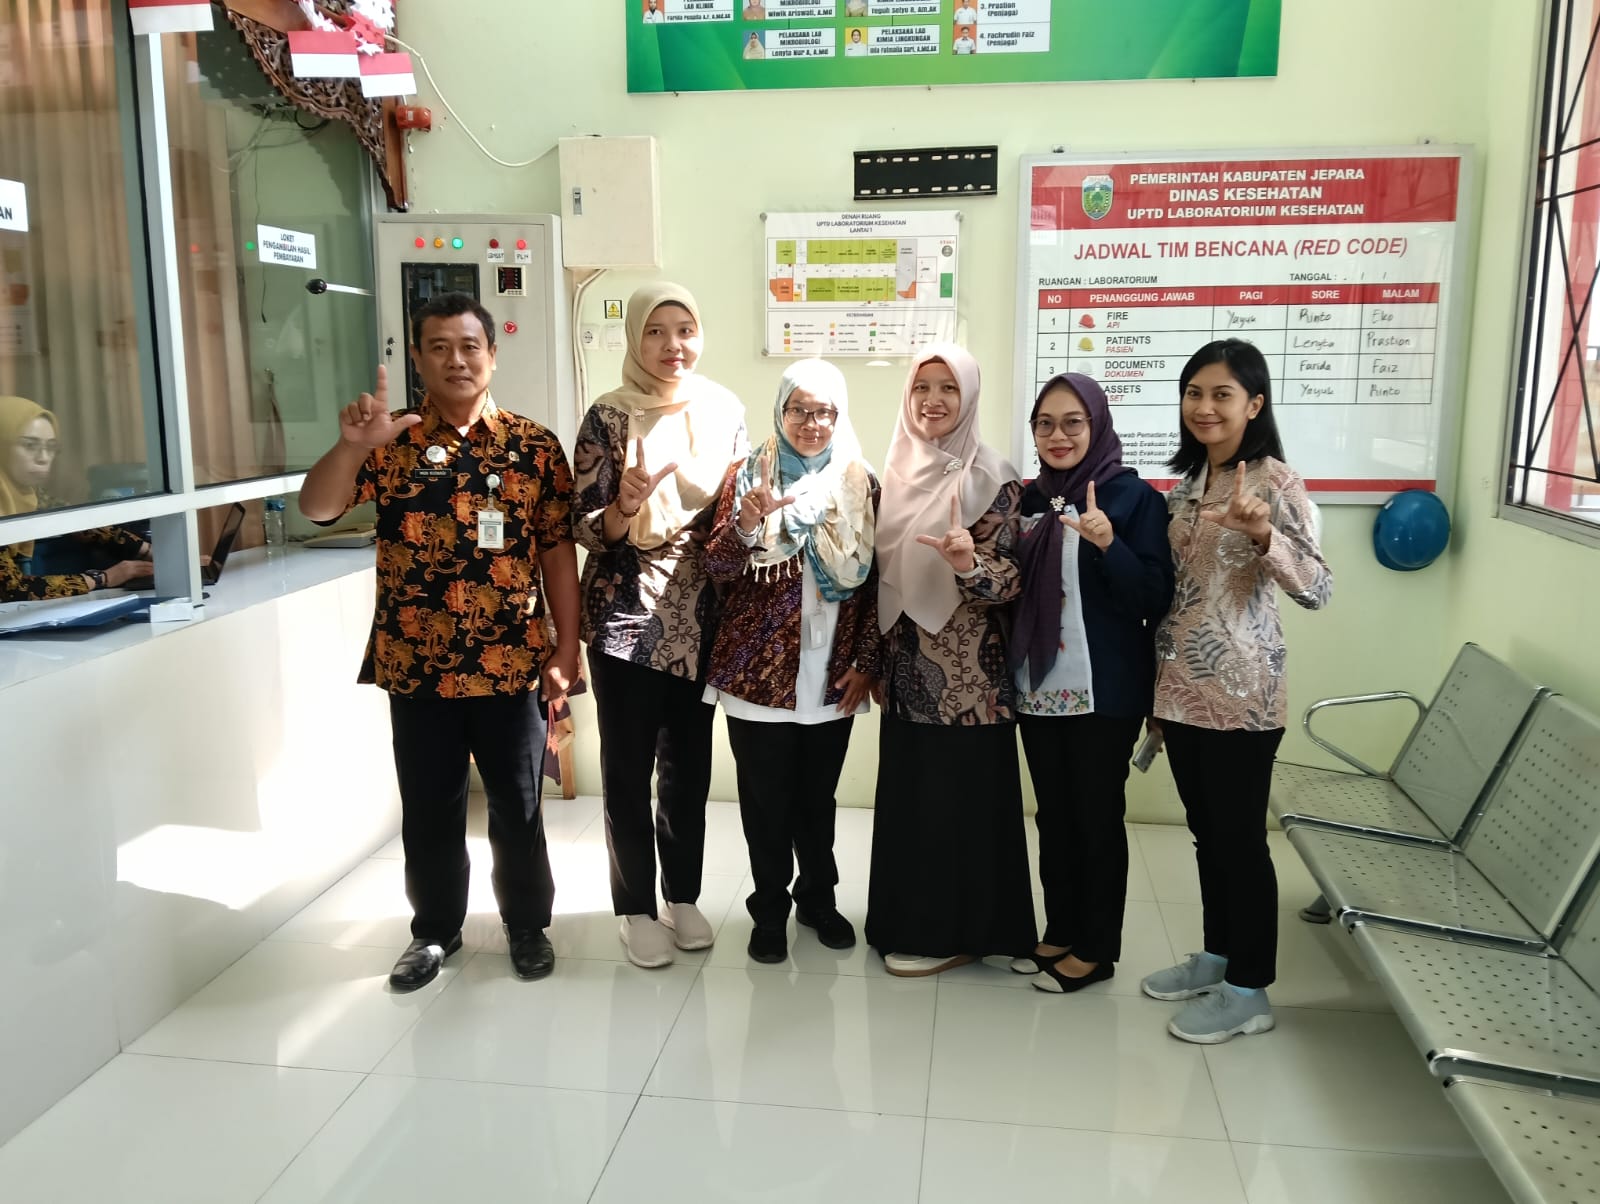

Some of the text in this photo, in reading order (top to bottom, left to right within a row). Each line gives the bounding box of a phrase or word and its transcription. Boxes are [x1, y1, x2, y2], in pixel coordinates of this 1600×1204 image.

[1130, 168, 1365, 184] PEMERINTAH KABUPATEN JEPARA
[1169, 186, 1322, 202] DINAS KESEHATAN
[1127, 204, 1364, 220] UPTD LABORATORIUM KESEHATAN
[280, 233, 295, 242] LOKET
[1073, 237, 1408, 260] JADWAL TIM BENCANA (RED CODE)
[1038, 277, 1081, 286] RUANGAN
[1088, 276, 1158, 286] LABORATORIUM
[1290, 273, 1332, 281] TANGGAL
[1047, 292, 1195, 304] NO PENANGGUNG JAWAB
[1239, 291, 1263, 300] PAGI
[1311, 289, 1341, 299] SORE
[1382, 289, 1420, 298] MALAM
[1051, 311, 1129, 325] 1 FIRE
[1372, 308, 1394, 324] Eko
[1106, 321, 1121, 329] API
[1050, 335, 1151, 350] 2 PATIENTS
[1105, 345, 1134, 353] PASIEN
[1049, 360, 1165, 374] 3 DOCUMENTS
[1371, 358, 1399, 374] Faiz
[1104, 370, 1144, 378] DOKUMEN
[1105, 384, 1142, 394] ASSETS
[1107, 394, 1125, 402] SET
